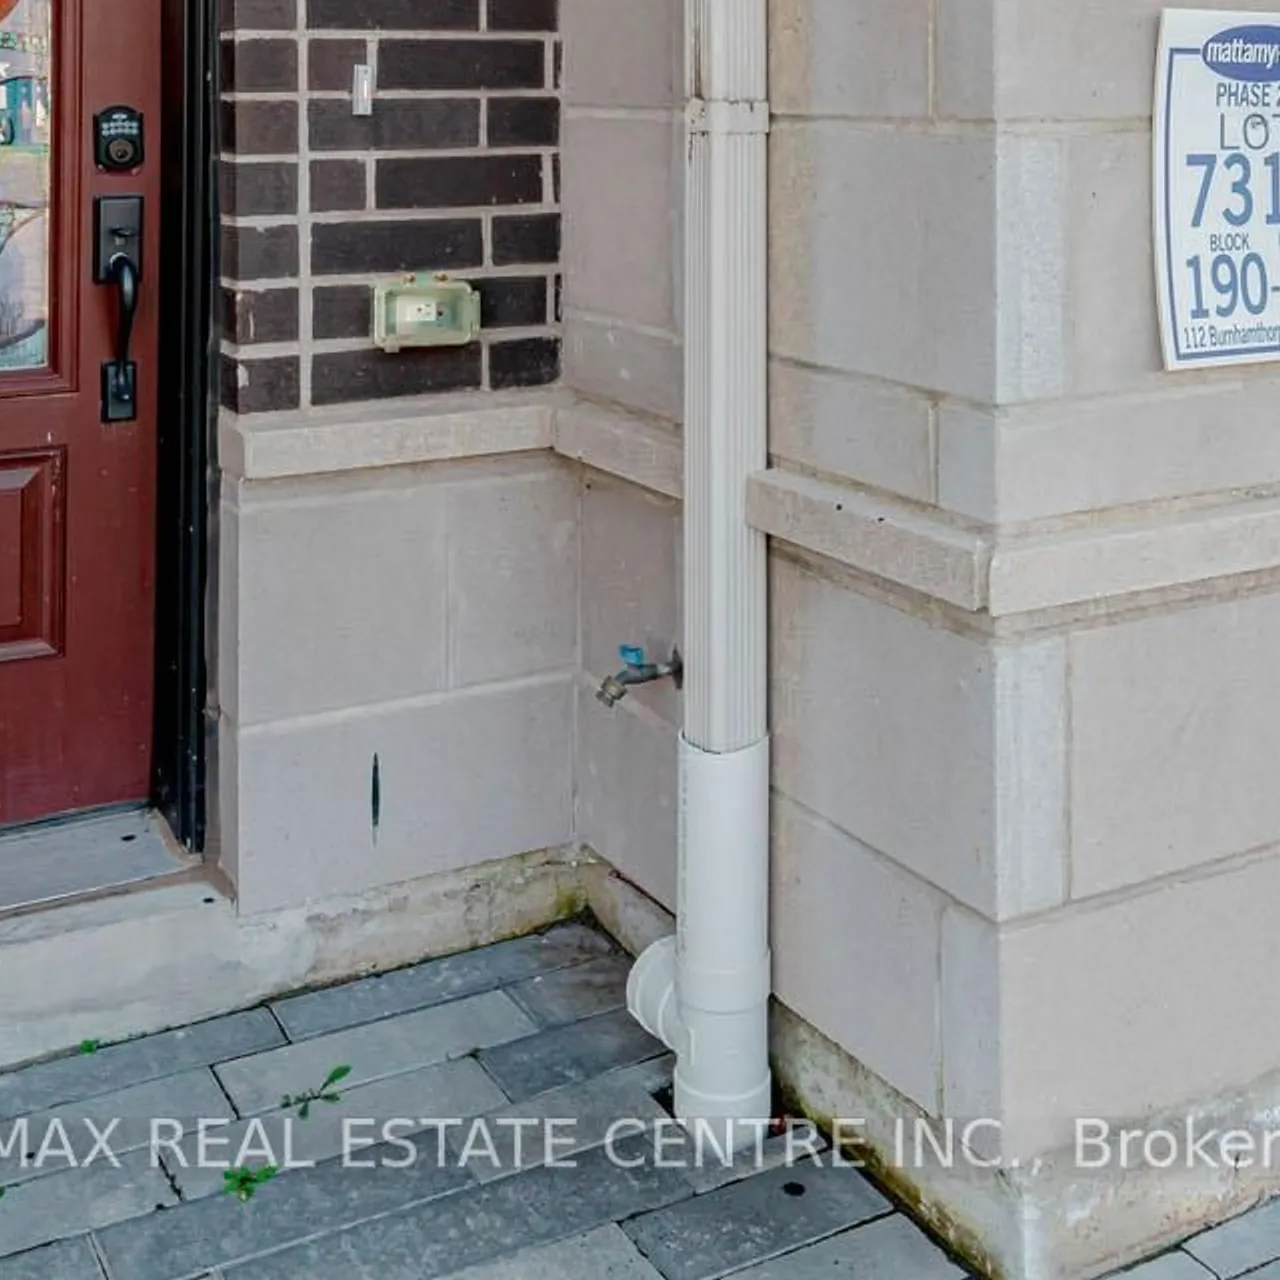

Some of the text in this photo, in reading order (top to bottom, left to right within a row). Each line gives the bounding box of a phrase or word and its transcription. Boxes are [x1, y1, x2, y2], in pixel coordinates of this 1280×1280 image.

[1216, 82, 1272, 107] PHASE
[1209, 233, 1251, 252] BLOCK
[1183, 325, 1208, 350] 112
